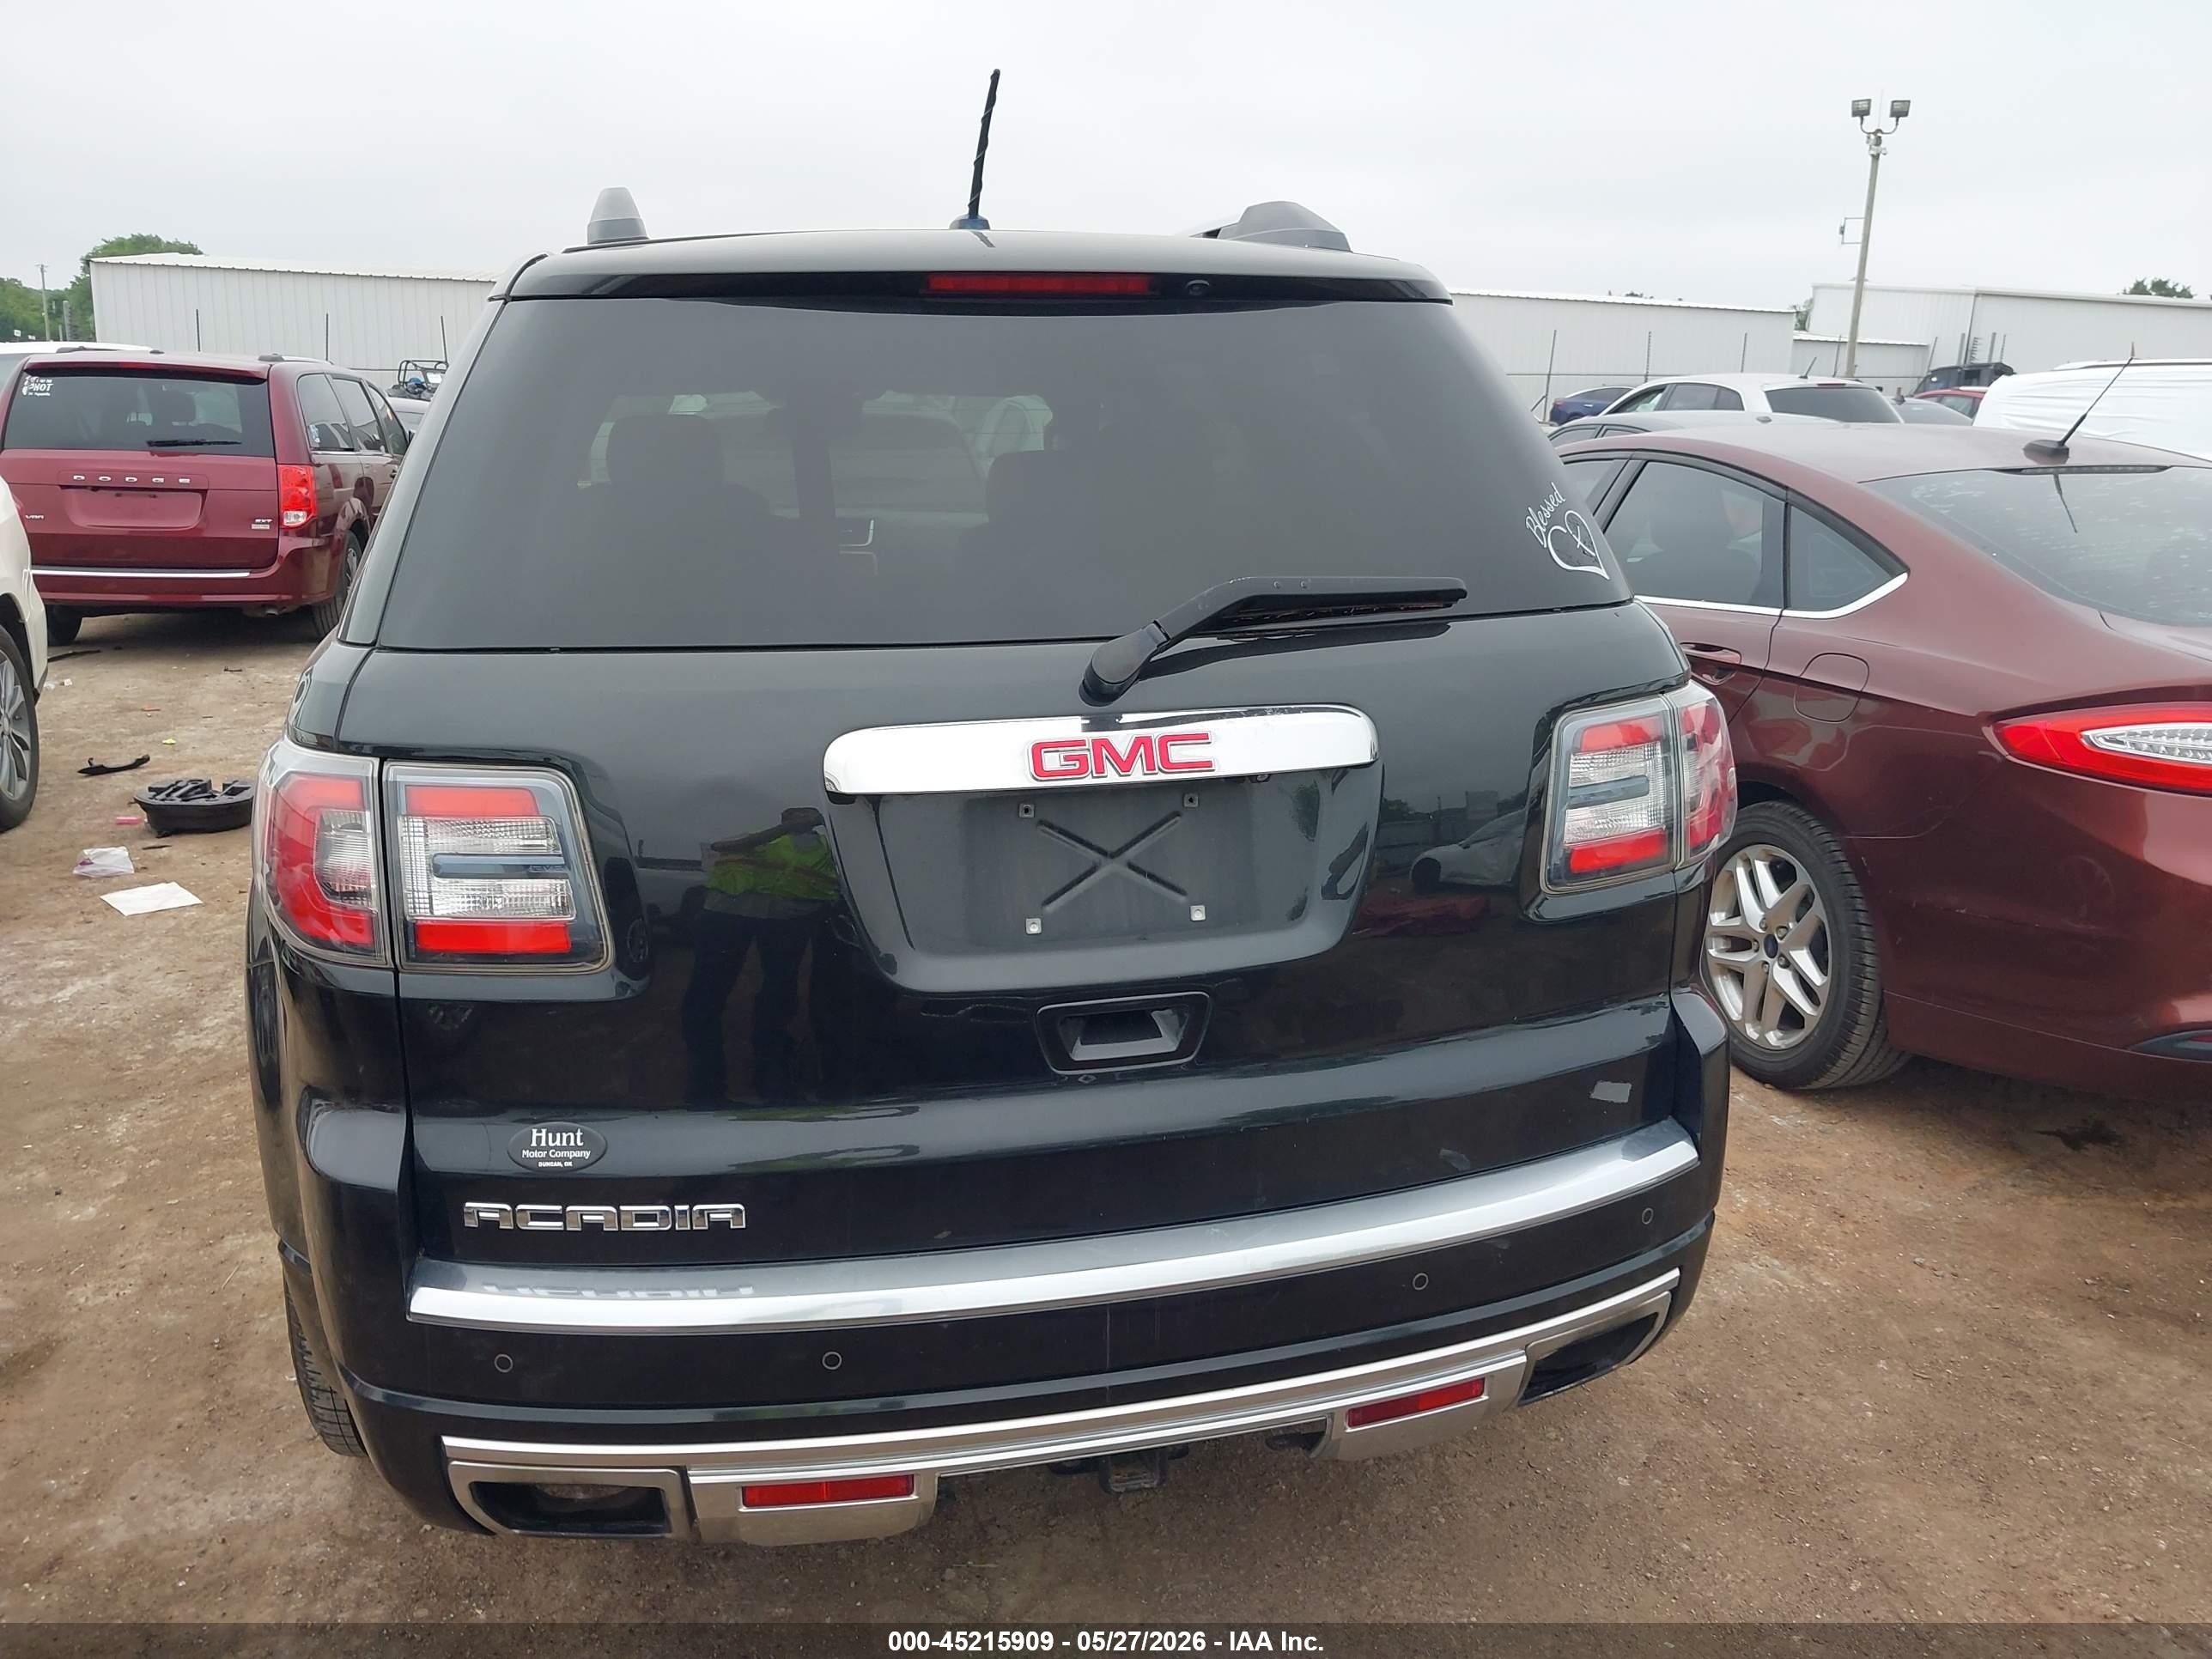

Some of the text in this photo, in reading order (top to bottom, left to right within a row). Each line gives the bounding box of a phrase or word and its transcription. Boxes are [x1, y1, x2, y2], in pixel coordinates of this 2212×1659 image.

[73, 475, 191, 483] DODGE
[1526, 482, 1566, 548] Blessed
[1030, 732, 1215, 780] GMC
[531, 1127, 584, 1146] Hunt
[521, 1149, 591, 1159] Motor Company
[464, 1202, 746, 1231] ACADIA
